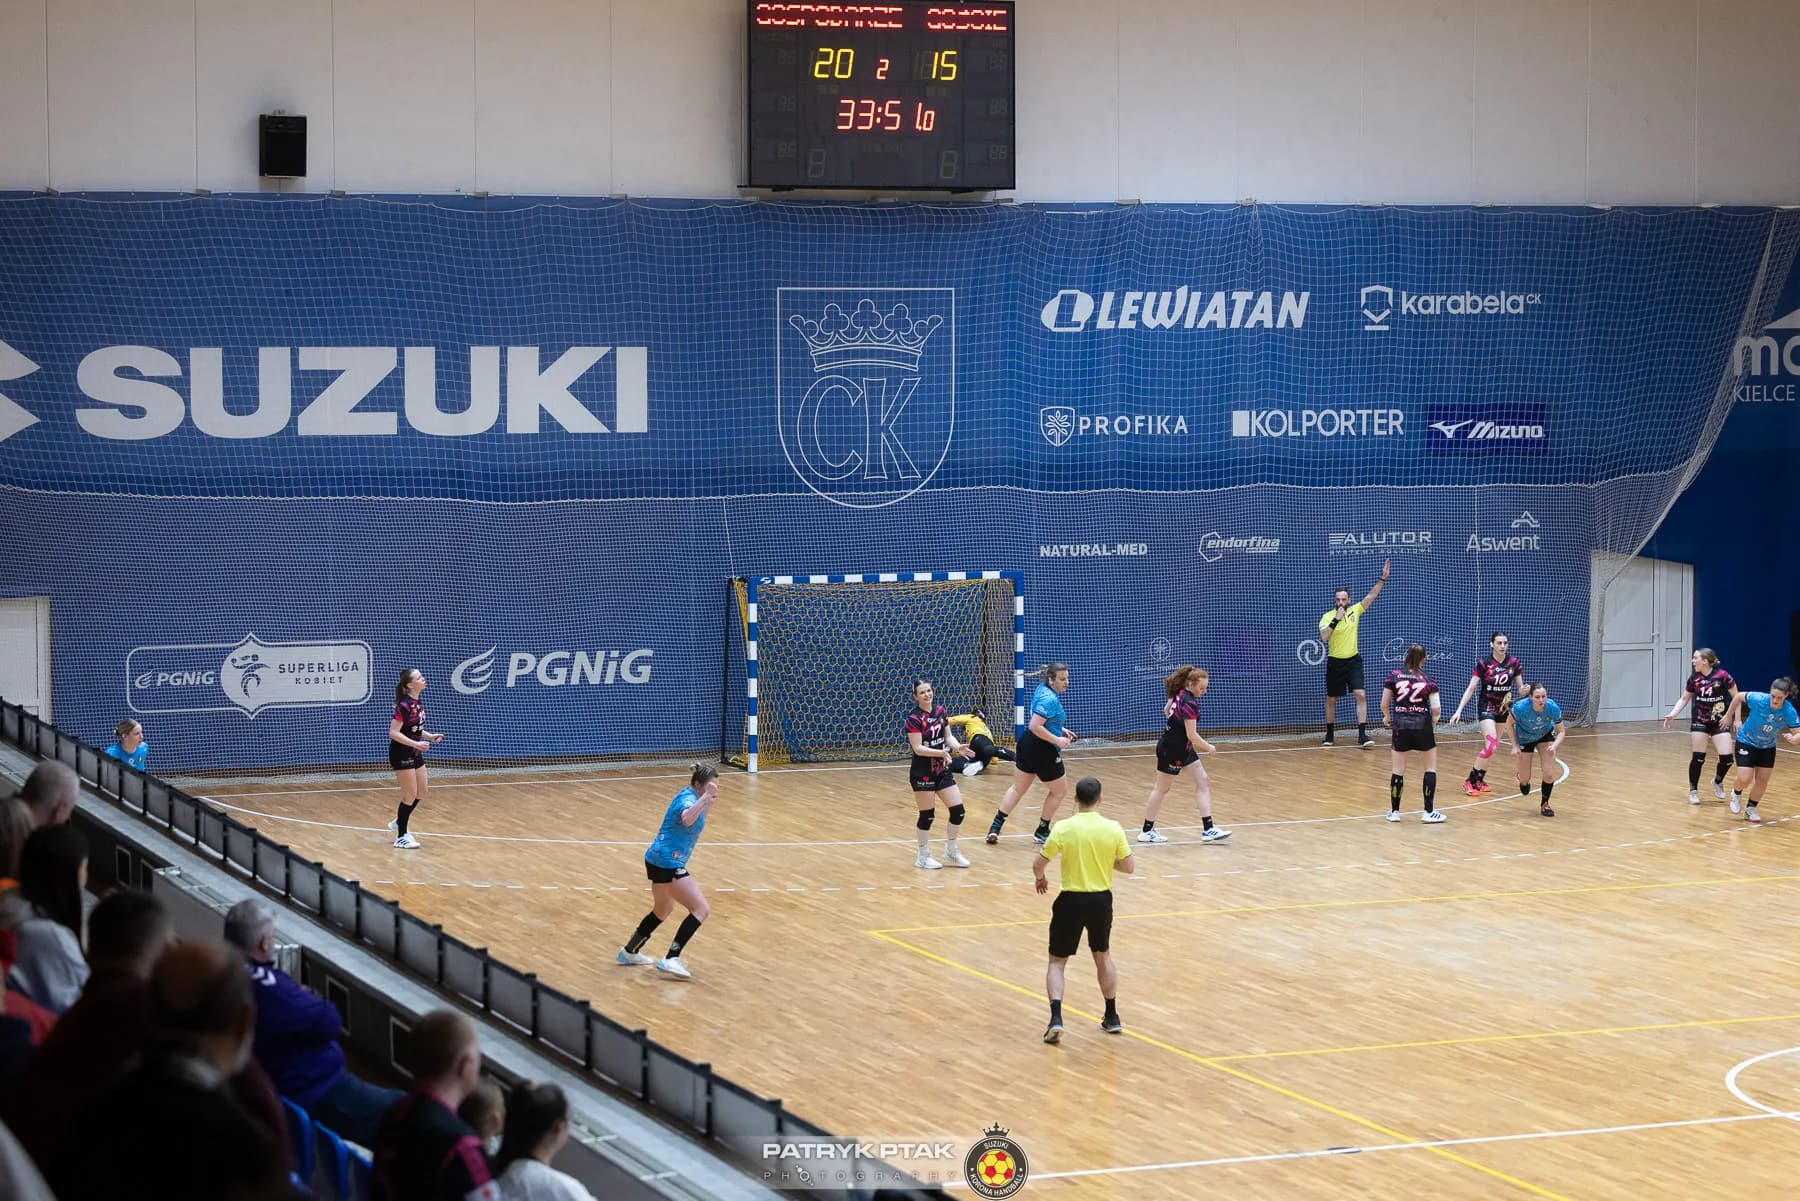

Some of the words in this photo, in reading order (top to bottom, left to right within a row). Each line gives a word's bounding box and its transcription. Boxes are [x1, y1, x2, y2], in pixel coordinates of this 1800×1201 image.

[814, 47, 854, 79] 20
[876, 59, 889, 80] 2
[932, 50, 957, 80] 15
[1096, 285, 1311, 330] LEWIATAN
[1402, 290, 1525, 315] karabela
[75, 345, 648, 440] SUZUKI
[1734, 384, 1797, 402] KIELCE
[797, 375, 921, 479] CK
[1079, 415, 1189, 436] PROFIKA
[1251, 409, 1404, 438] KOLPORTER
[1207, 536, 1281, 549] endorfina
[1343, 531, 1432, 545] ALUTOR
[1467, 533, 1540, 551] Aswent
[1040, 543, 1148, 557] NATURAL-MED
[278, 661, 360, 674] SUPERLIGA
[506, 649, 654, 688] PGNiG
[157, 671, 215, 687] PGNiG
[295, 676, 344, 685] KOBIET
[1494, 674, 1509, 685] 10
[1395, 680, 1427, 703] 32
[1700, 686, 1713, 697] 14
[930, 723, 942, 739] 17
